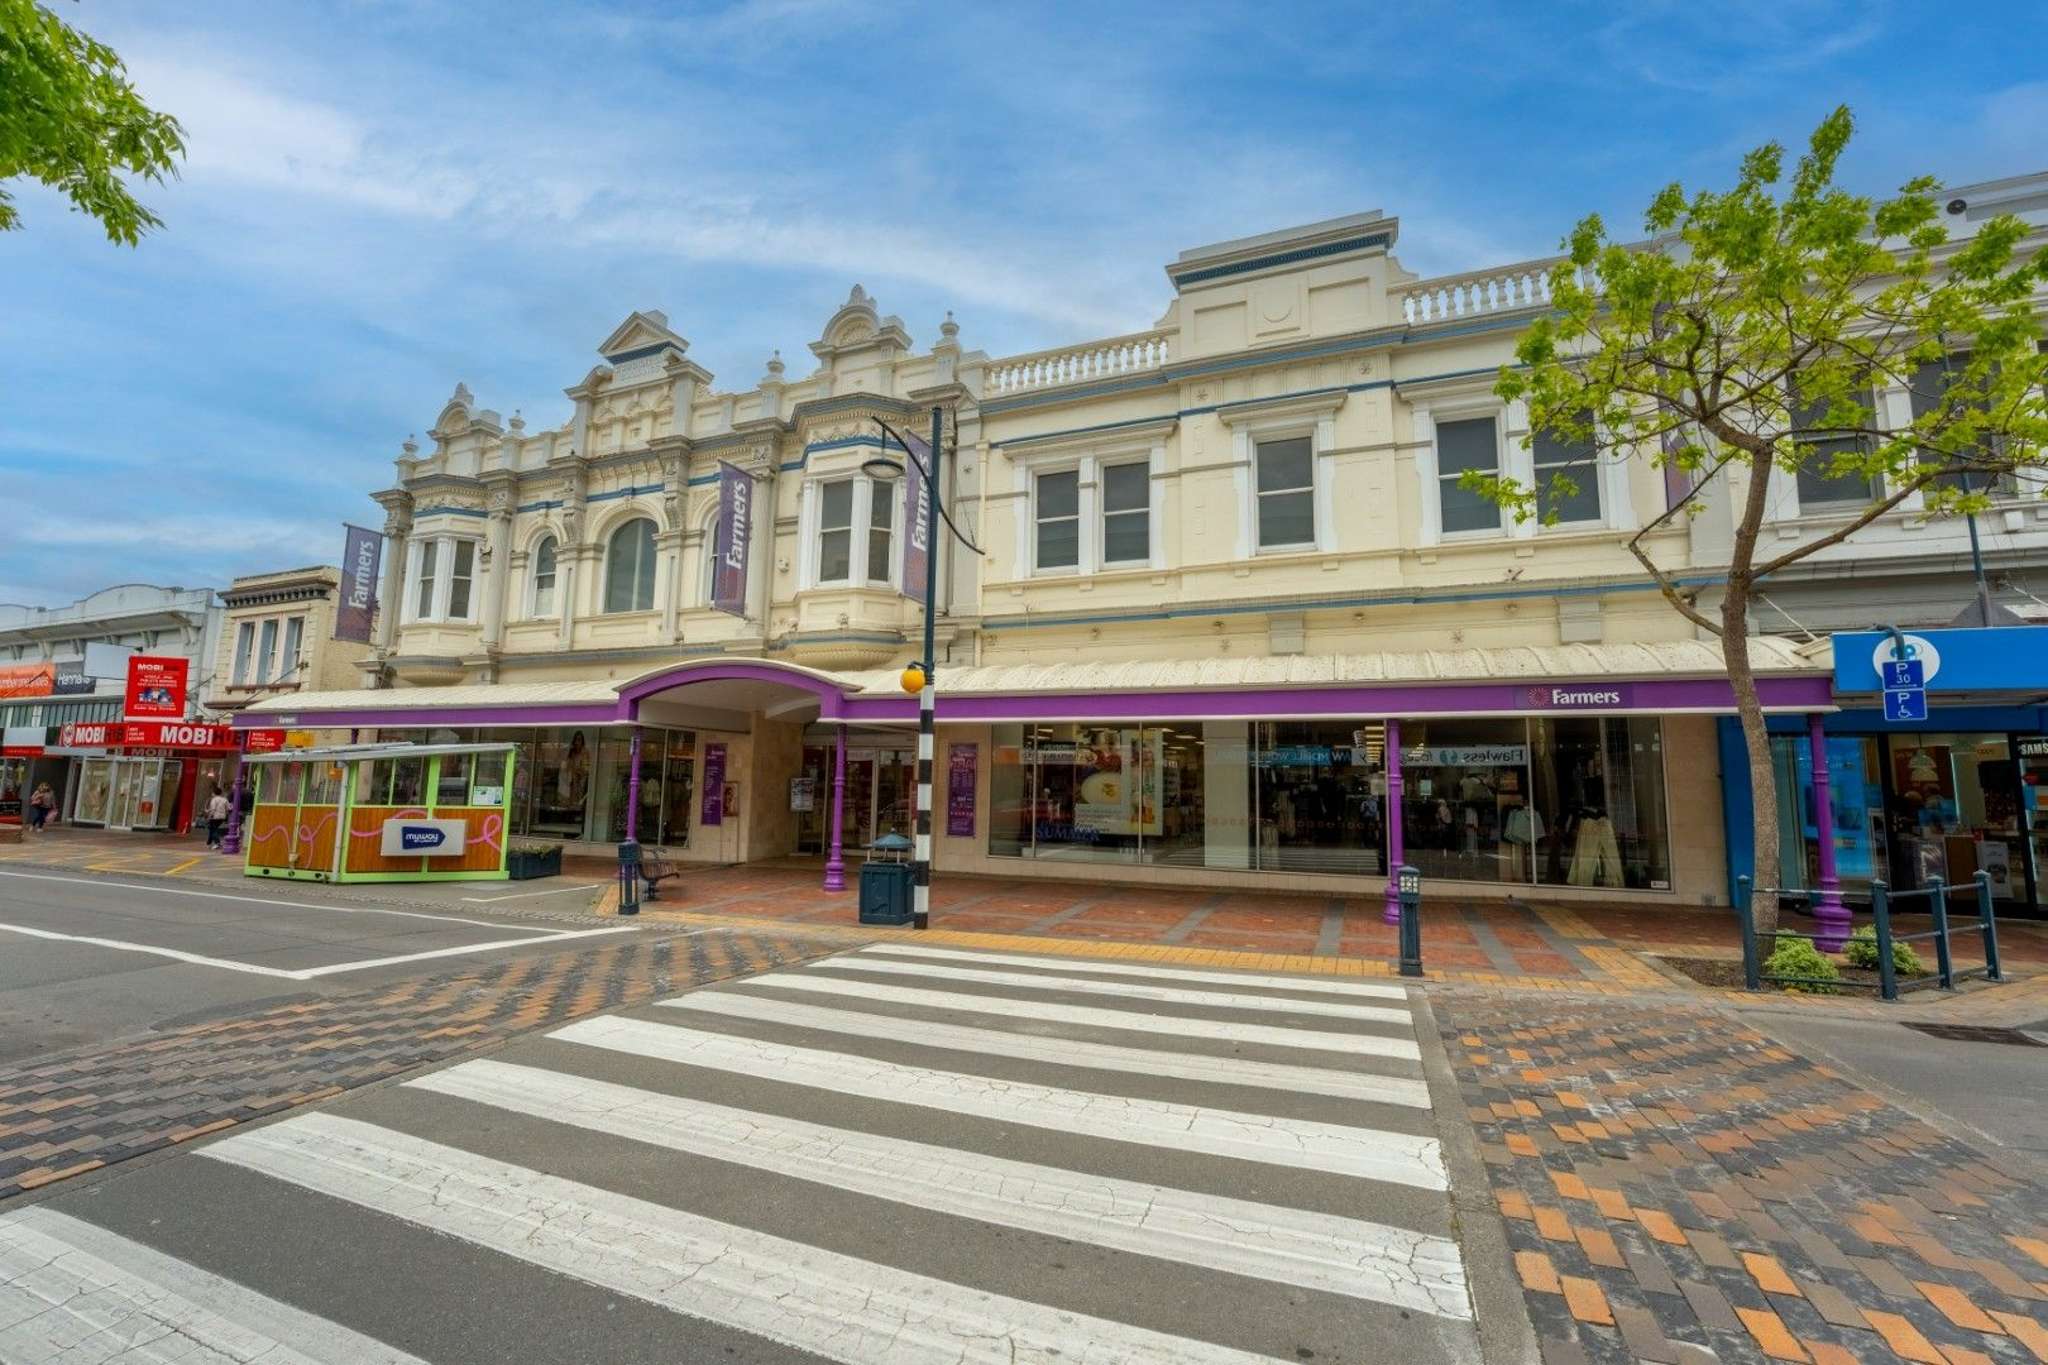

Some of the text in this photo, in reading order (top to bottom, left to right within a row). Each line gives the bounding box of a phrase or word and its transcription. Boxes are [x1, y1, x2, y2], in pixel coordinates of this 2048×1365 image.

[726, 480, 747, 570] Farmers
[348, 540, 375, 609] Farmers
[1896, 663, 1908, 673] P
[1896, 674, 1911, 683] 30
[1552, 688, 1620, 705] Farmers
[1897, 692, 1910, 704] P
[405, 833, 439, 843] myway
